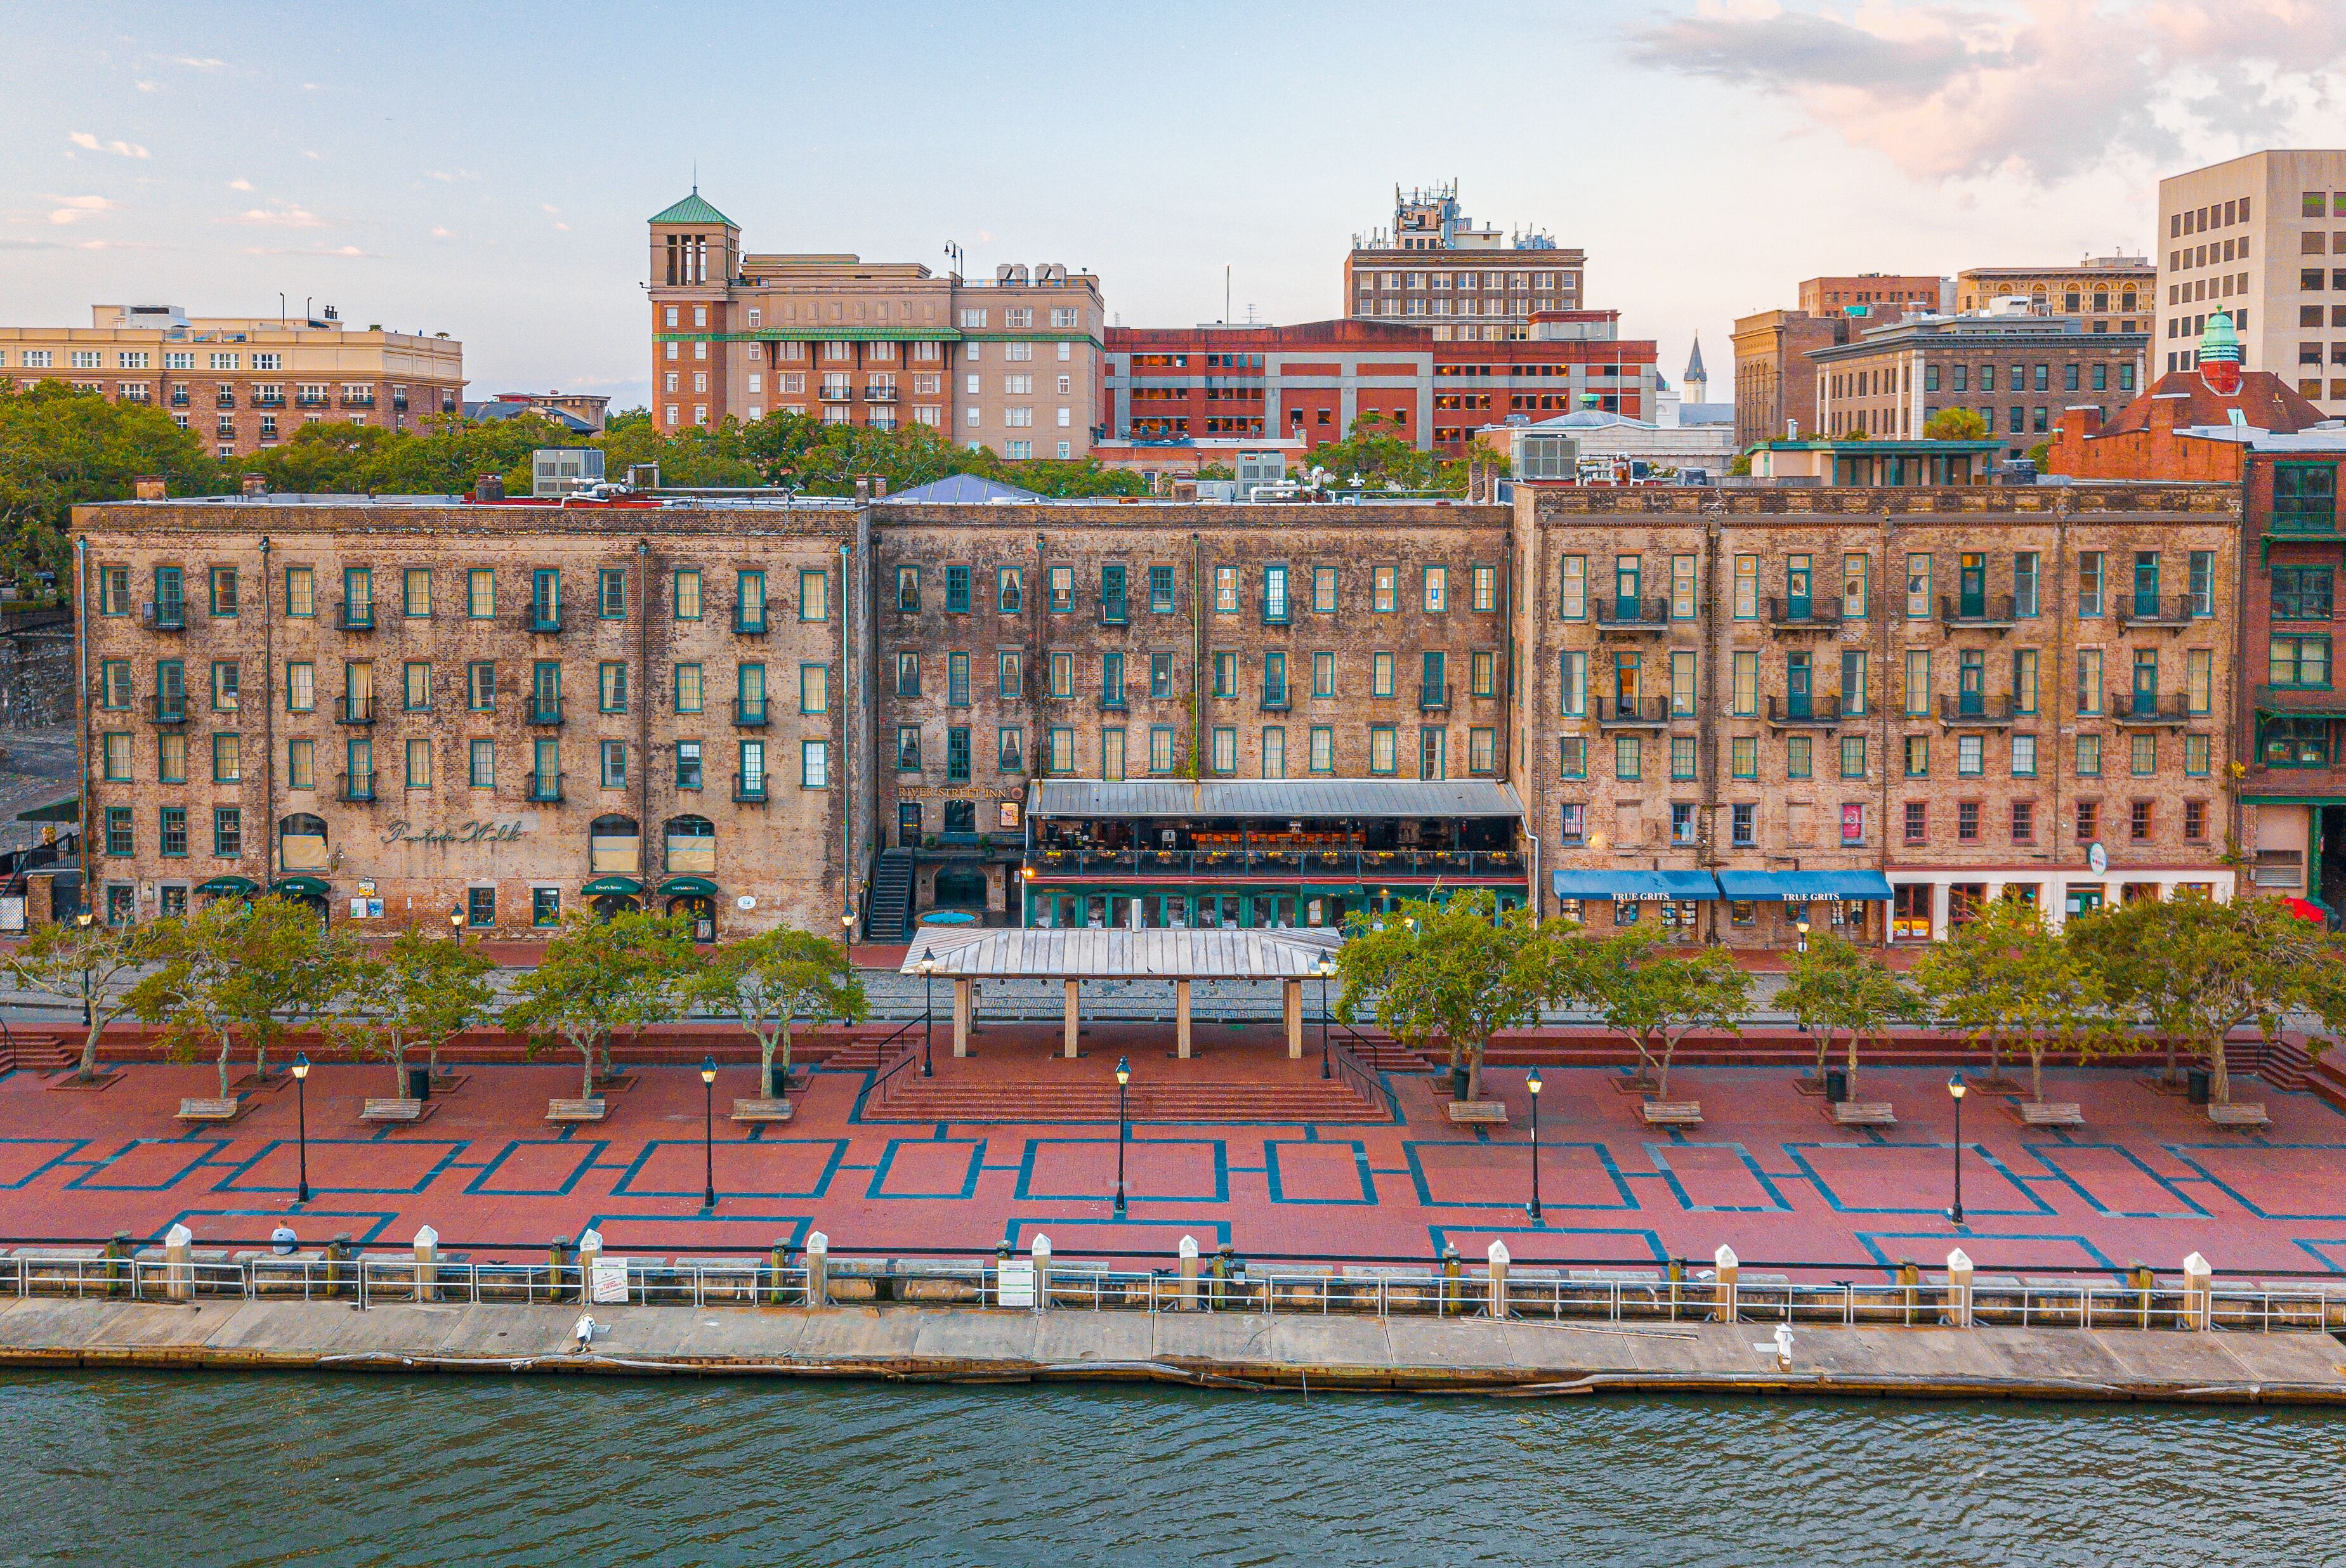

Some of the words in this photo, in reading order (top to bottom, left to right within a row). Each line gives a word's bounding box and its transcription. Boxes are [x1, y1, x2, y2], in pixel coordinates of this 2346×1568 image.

[898, 787, 934, 797] RIVER
[938, 788, 981, 798] STREET
[985, 789, 1007, 798] INN
[1611, 892, 1639, 901] TRUE
[1640, 892, 1670, 901] GRITS
